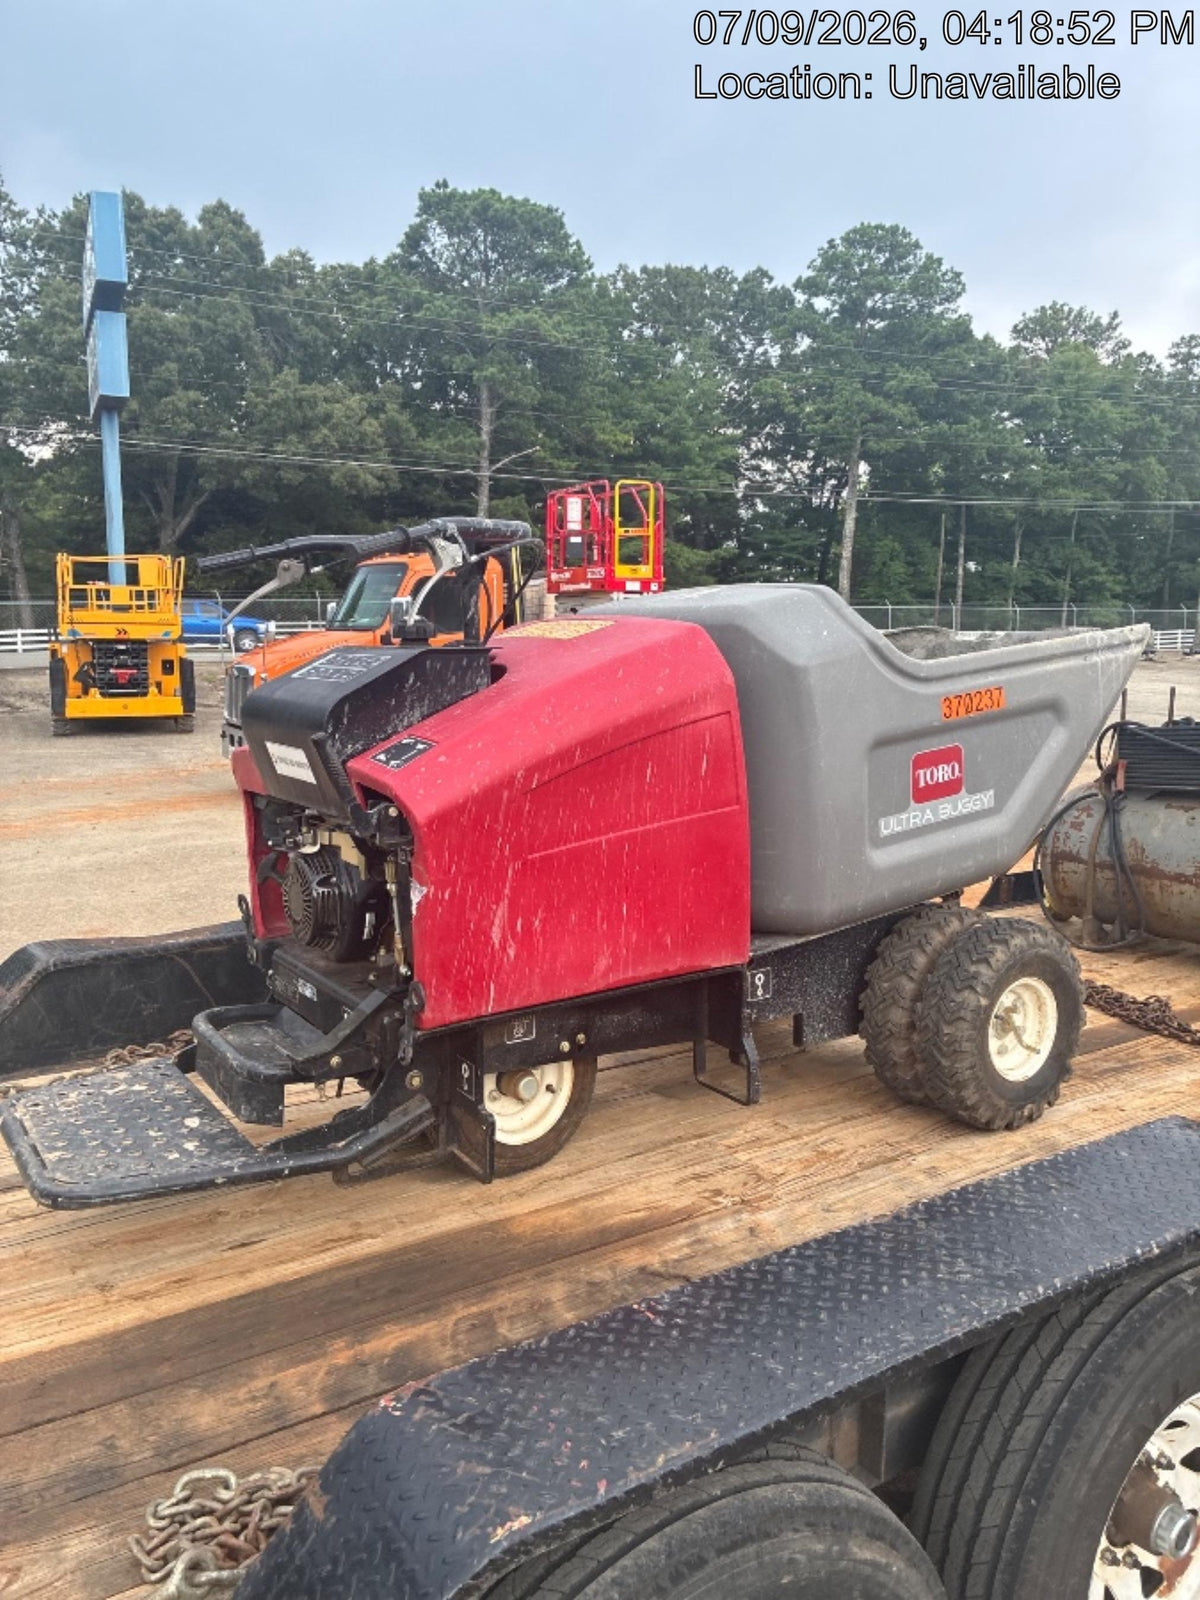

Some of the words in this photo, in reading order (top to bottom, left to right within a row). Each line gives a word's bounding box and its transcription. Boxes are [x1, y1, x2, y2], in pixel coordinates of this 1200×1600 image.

[942, 686, 1004, 719] 370237
[914, 761, 961, 789] TORO
[880, 808, 934, 835] ULTRA
[938, 789, 994, 820] BUGGY
